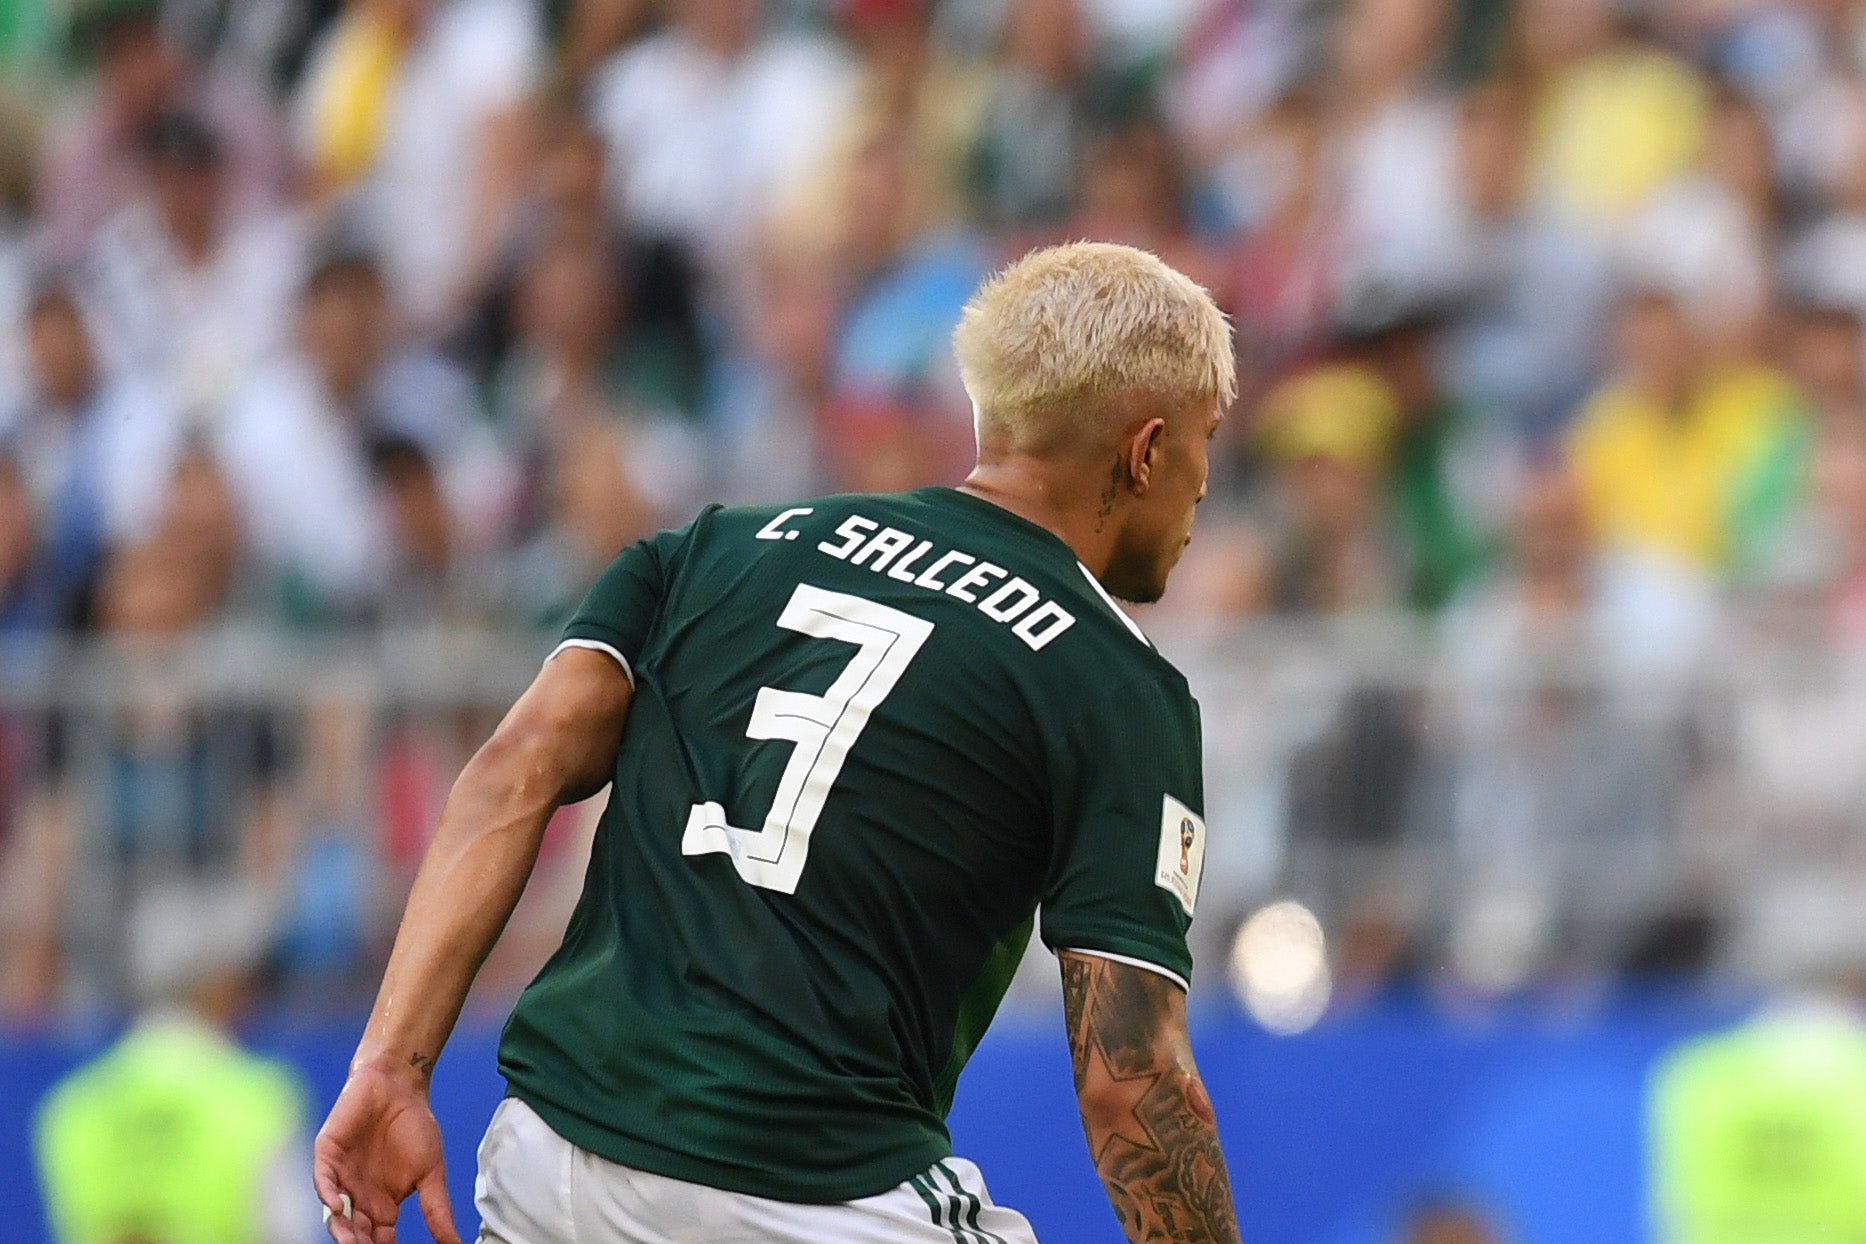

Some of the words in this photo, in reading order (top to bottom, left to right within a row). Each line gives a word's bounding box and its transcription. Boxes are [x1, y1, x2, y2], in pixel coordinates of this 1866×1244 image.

[755, 508, 814, 541] C.
[817, 514, 1077, 652] SALCEDO
[682, 582, 936, 895] 3
